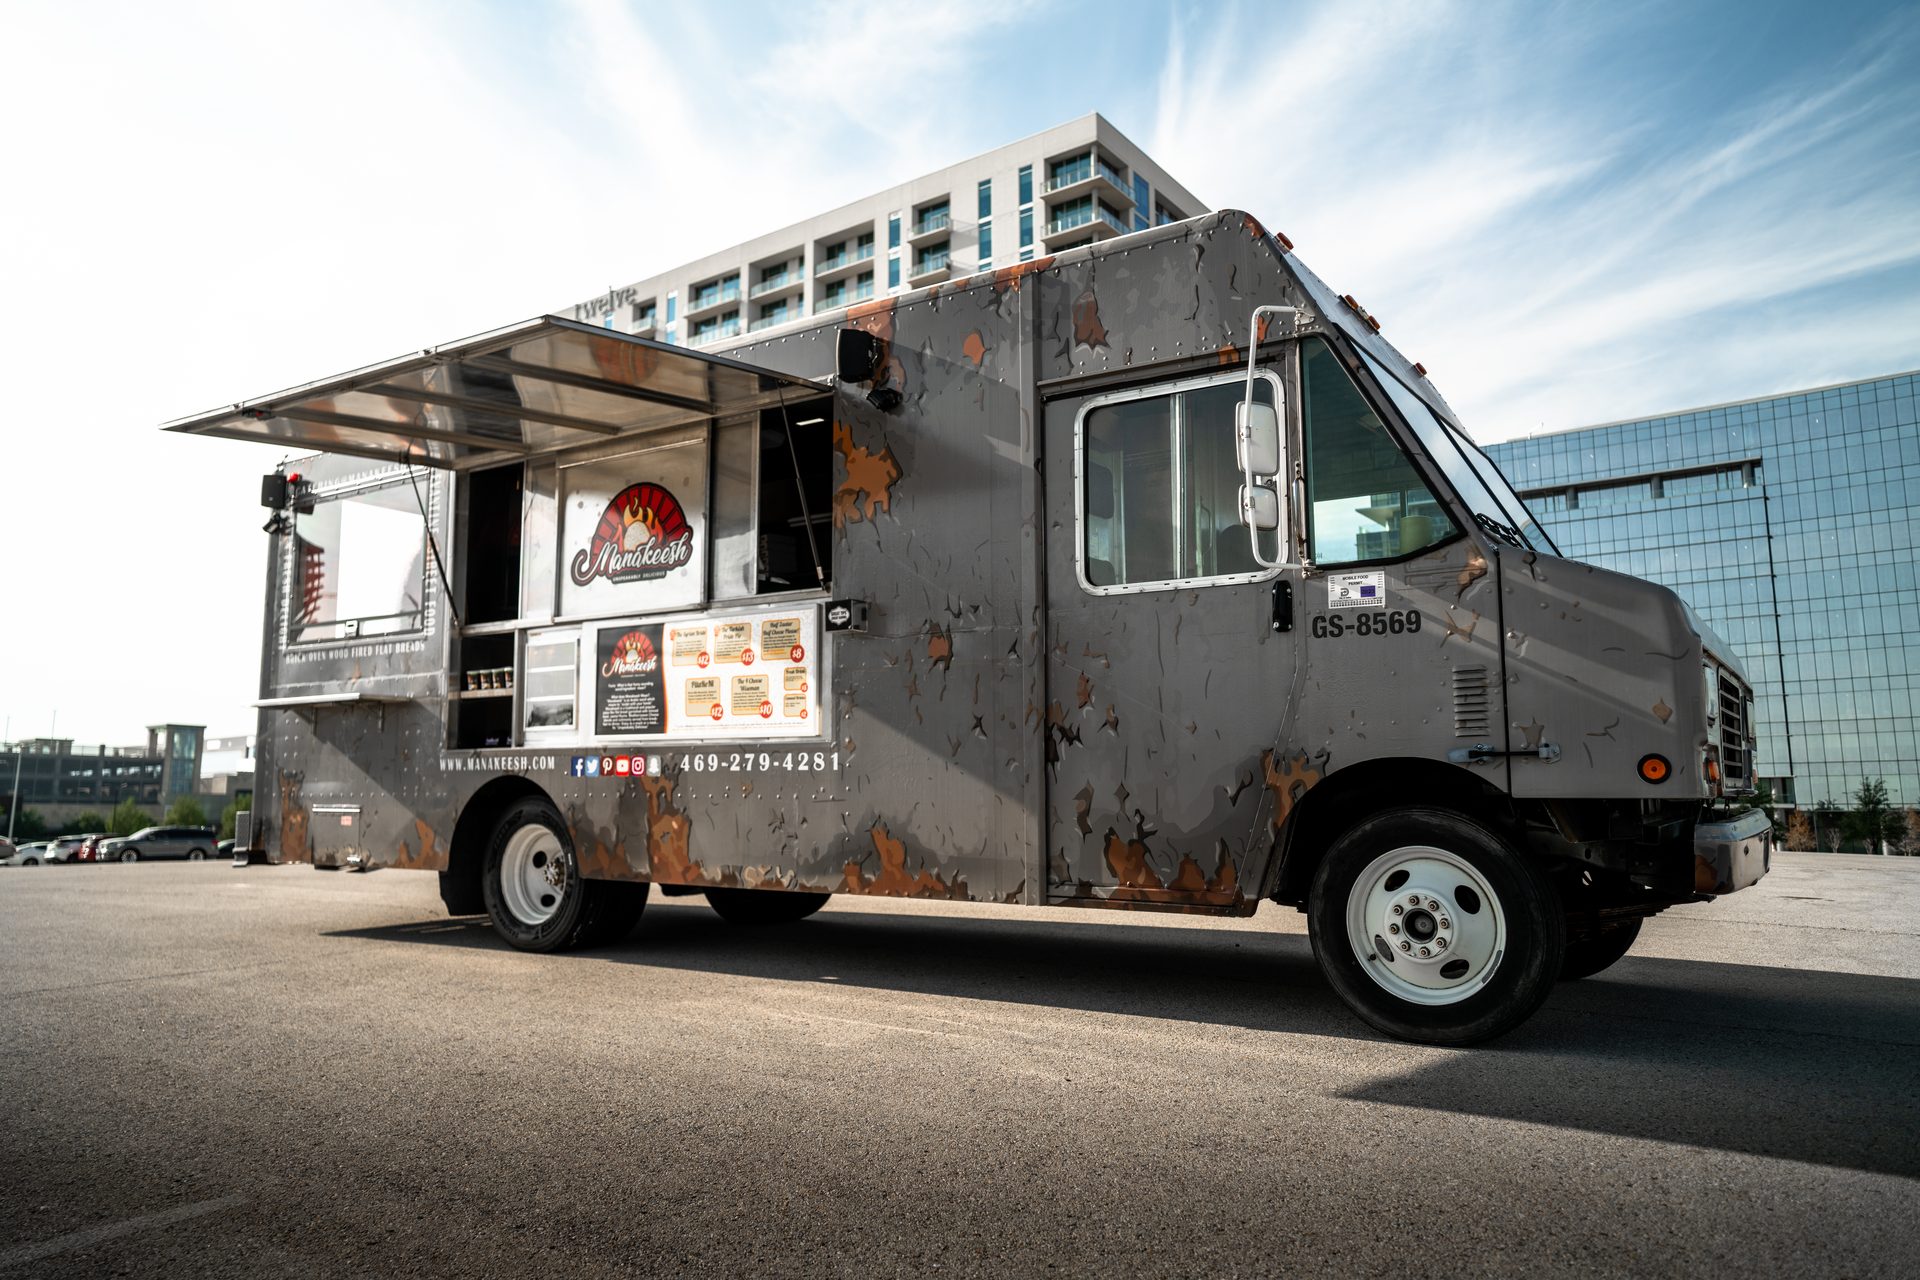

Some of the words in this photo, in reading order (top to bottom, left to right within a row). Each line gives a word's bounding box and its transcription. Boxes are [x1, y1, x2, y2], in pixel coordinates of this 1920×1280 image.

[574, 531, 690, 581] Manakeesh
[423, 601, 437, 636] FOOD
[1312, 609, 1422, 638] GS-8569
[329, 648, 349, 660] WOOD
[351, 645, 373, 658] FIRED
[375, 643, 393, 656] FLAT
[395, 640, 425, 654] BREADS
[698, 655, 709, 665] $12
[792, 648, 802, 659] $8
[602, 655, 658, 677] Manakeesh
[711, 707, 722, 717] $12
[760, 703, 772, 715] $10
[439, 756, 555, 771] WWW.MANAKEESH.COM
[680, 752, 839, 772] 469-279-4281
